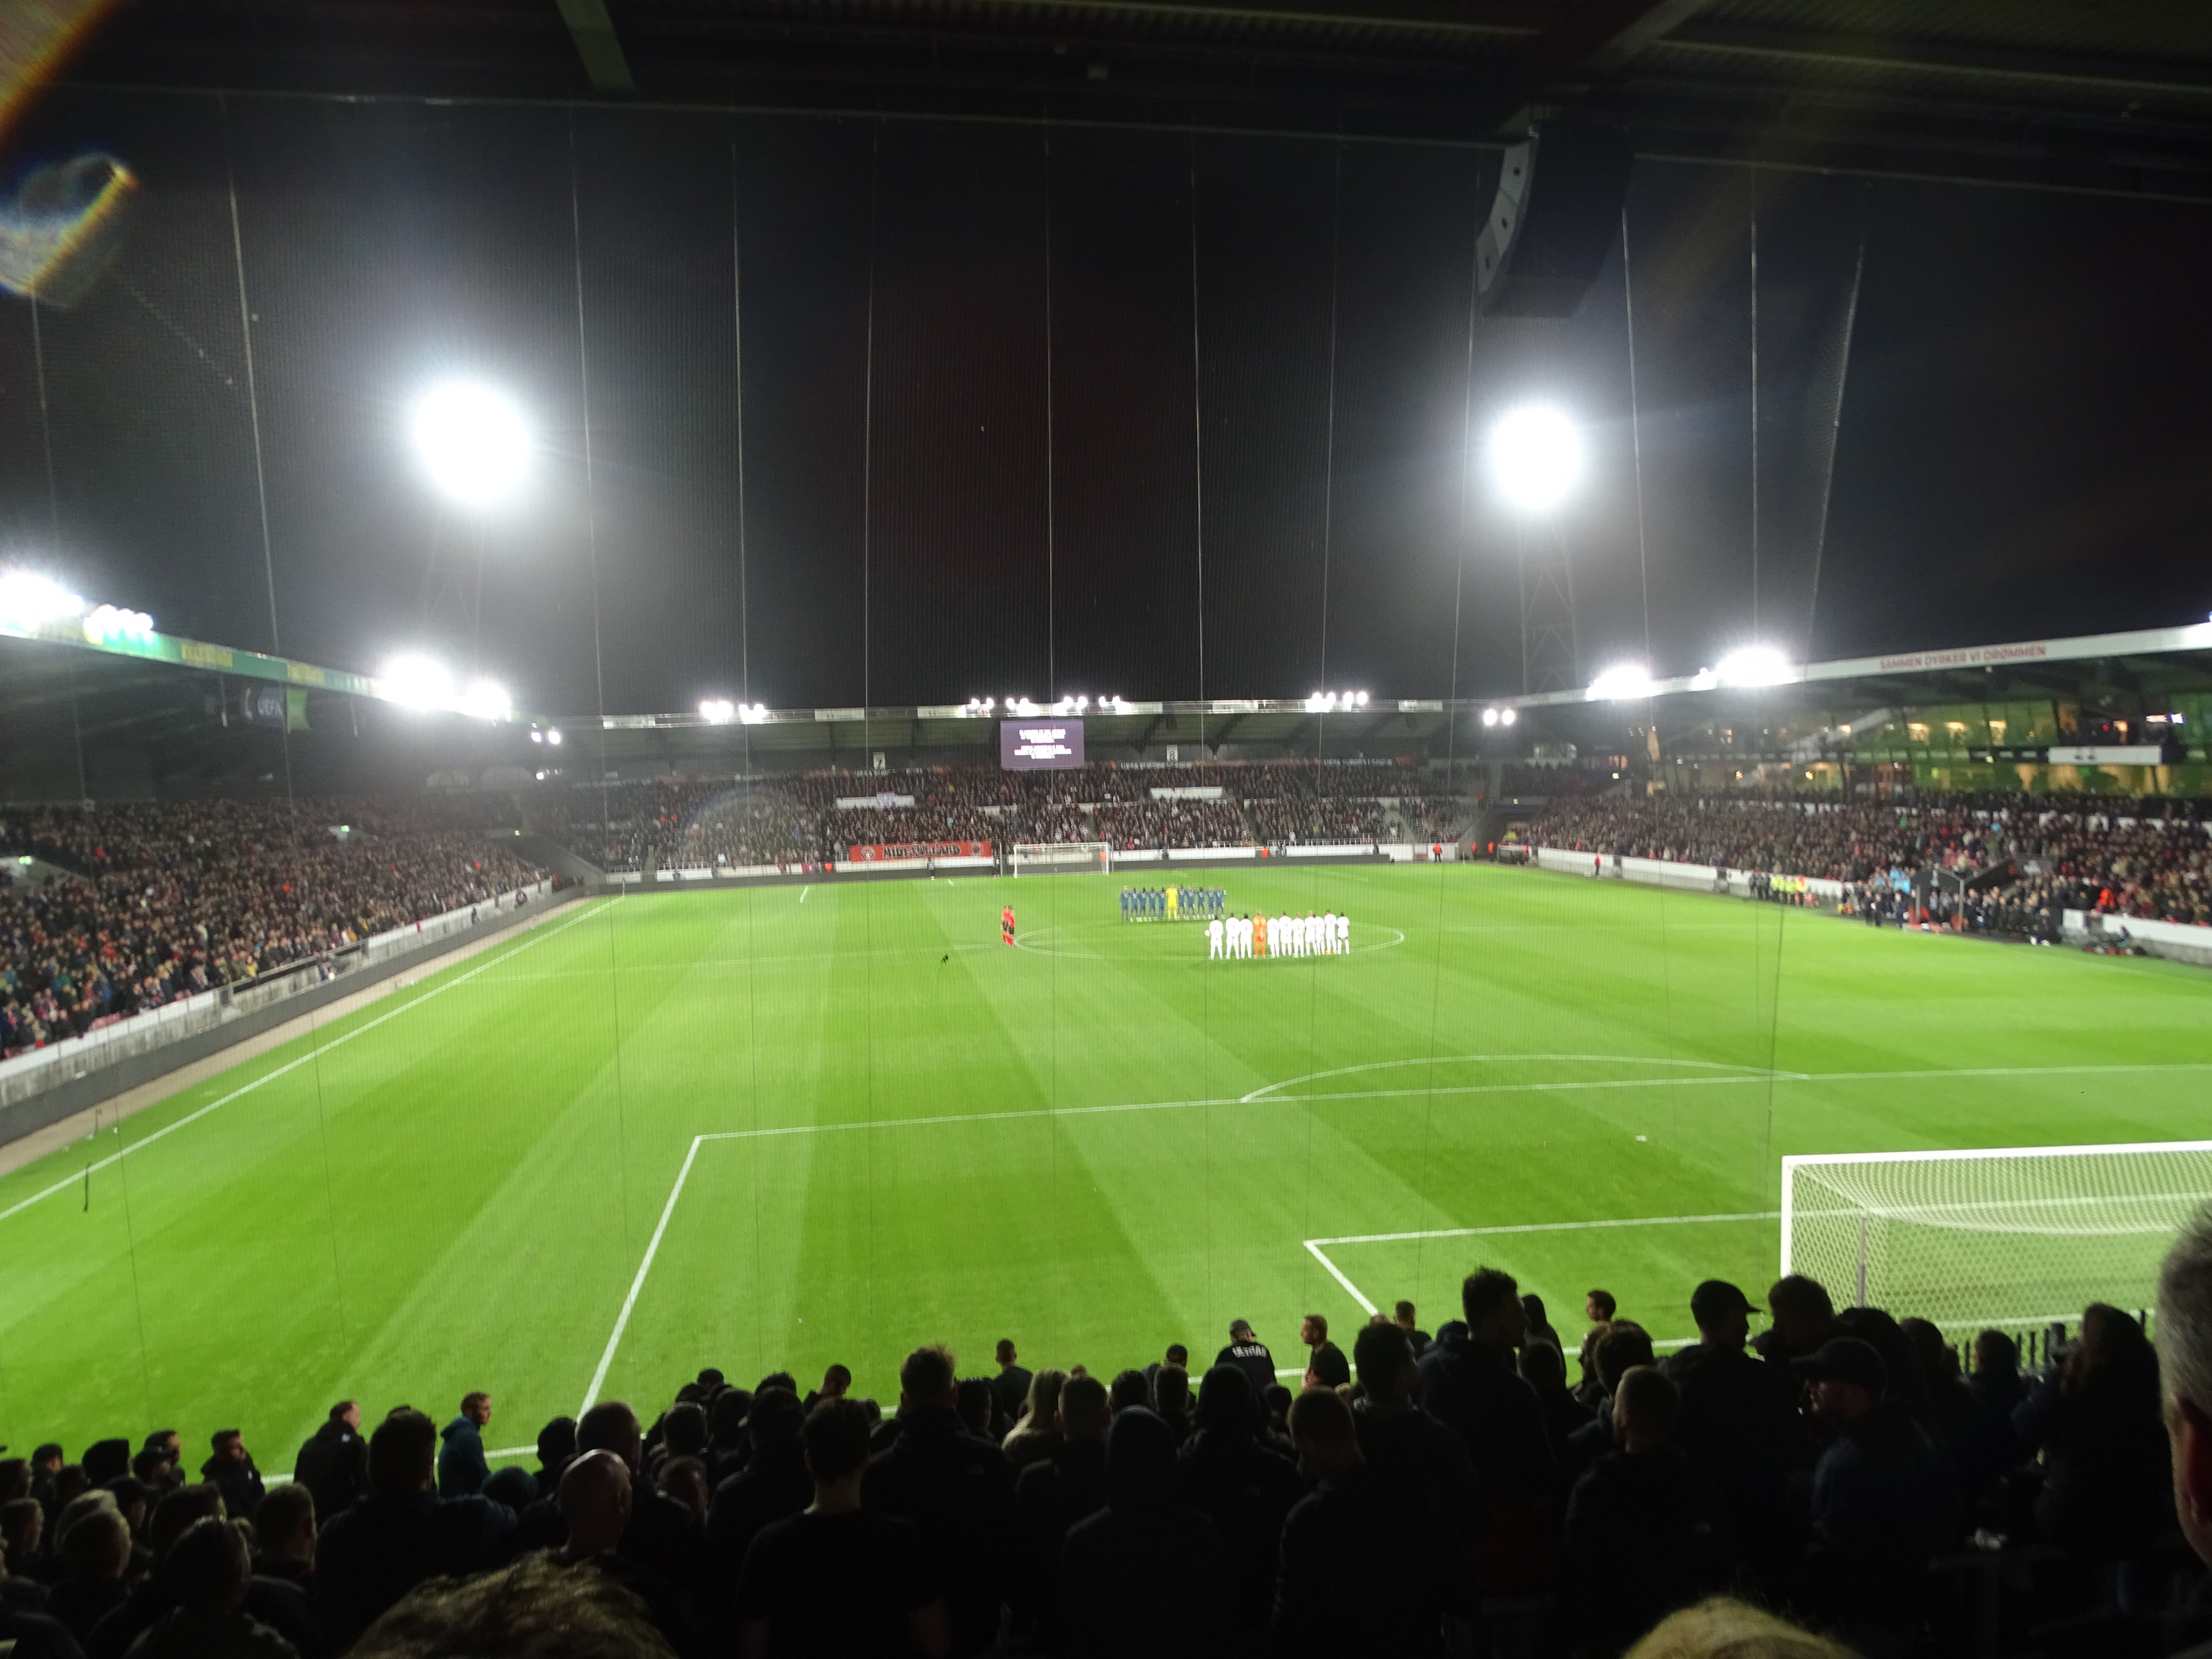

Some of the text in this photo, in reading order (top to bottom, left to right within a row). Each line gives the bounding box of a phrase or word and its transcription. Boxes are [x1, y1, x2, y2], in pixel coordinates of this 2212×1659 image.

[1120, 760, 1192, 771] UEFA EUROPA LEAGUE
